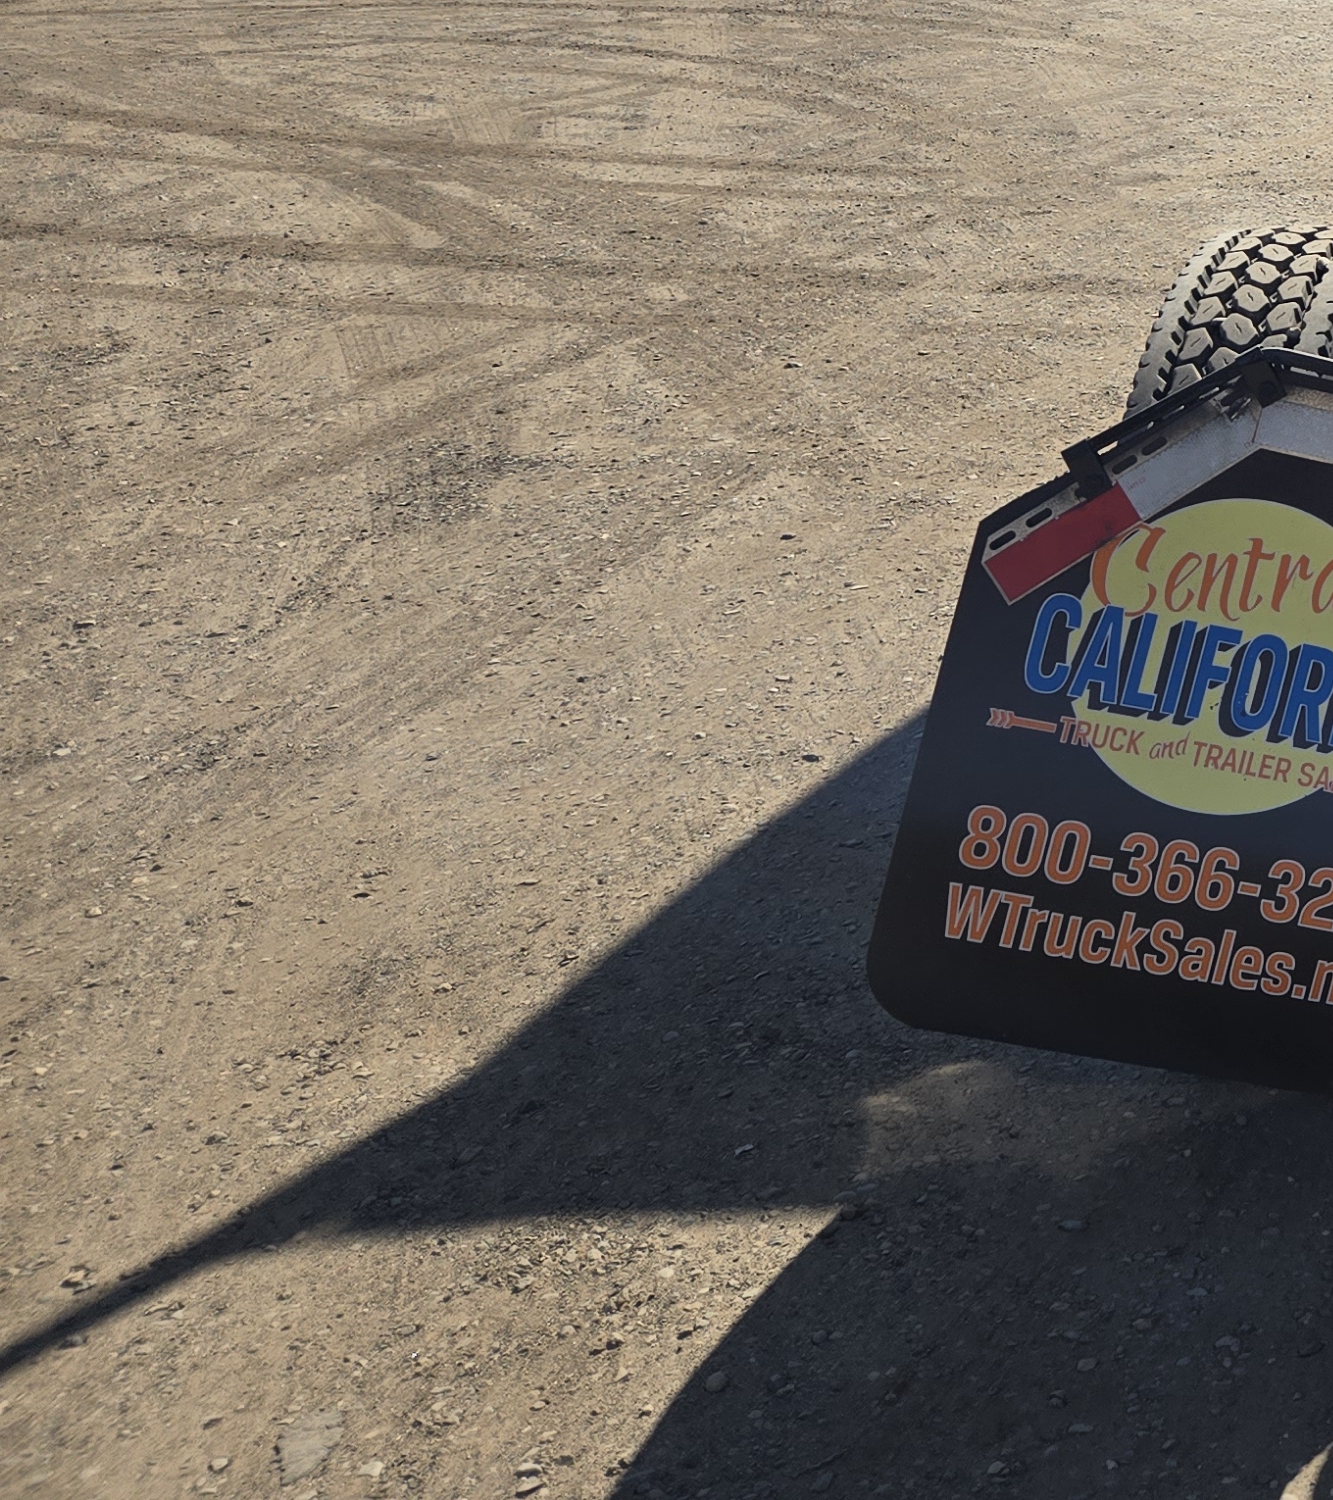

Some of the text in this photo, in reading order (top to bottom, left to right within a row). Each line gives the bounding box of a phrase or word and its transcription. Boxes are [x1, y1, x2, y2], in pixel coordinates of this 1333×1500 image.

[1059, 715, 1143, 758] TRUCK
[1149, 729, 1189, 761] and
[1192, 739, 1292, 785] TRAILER
